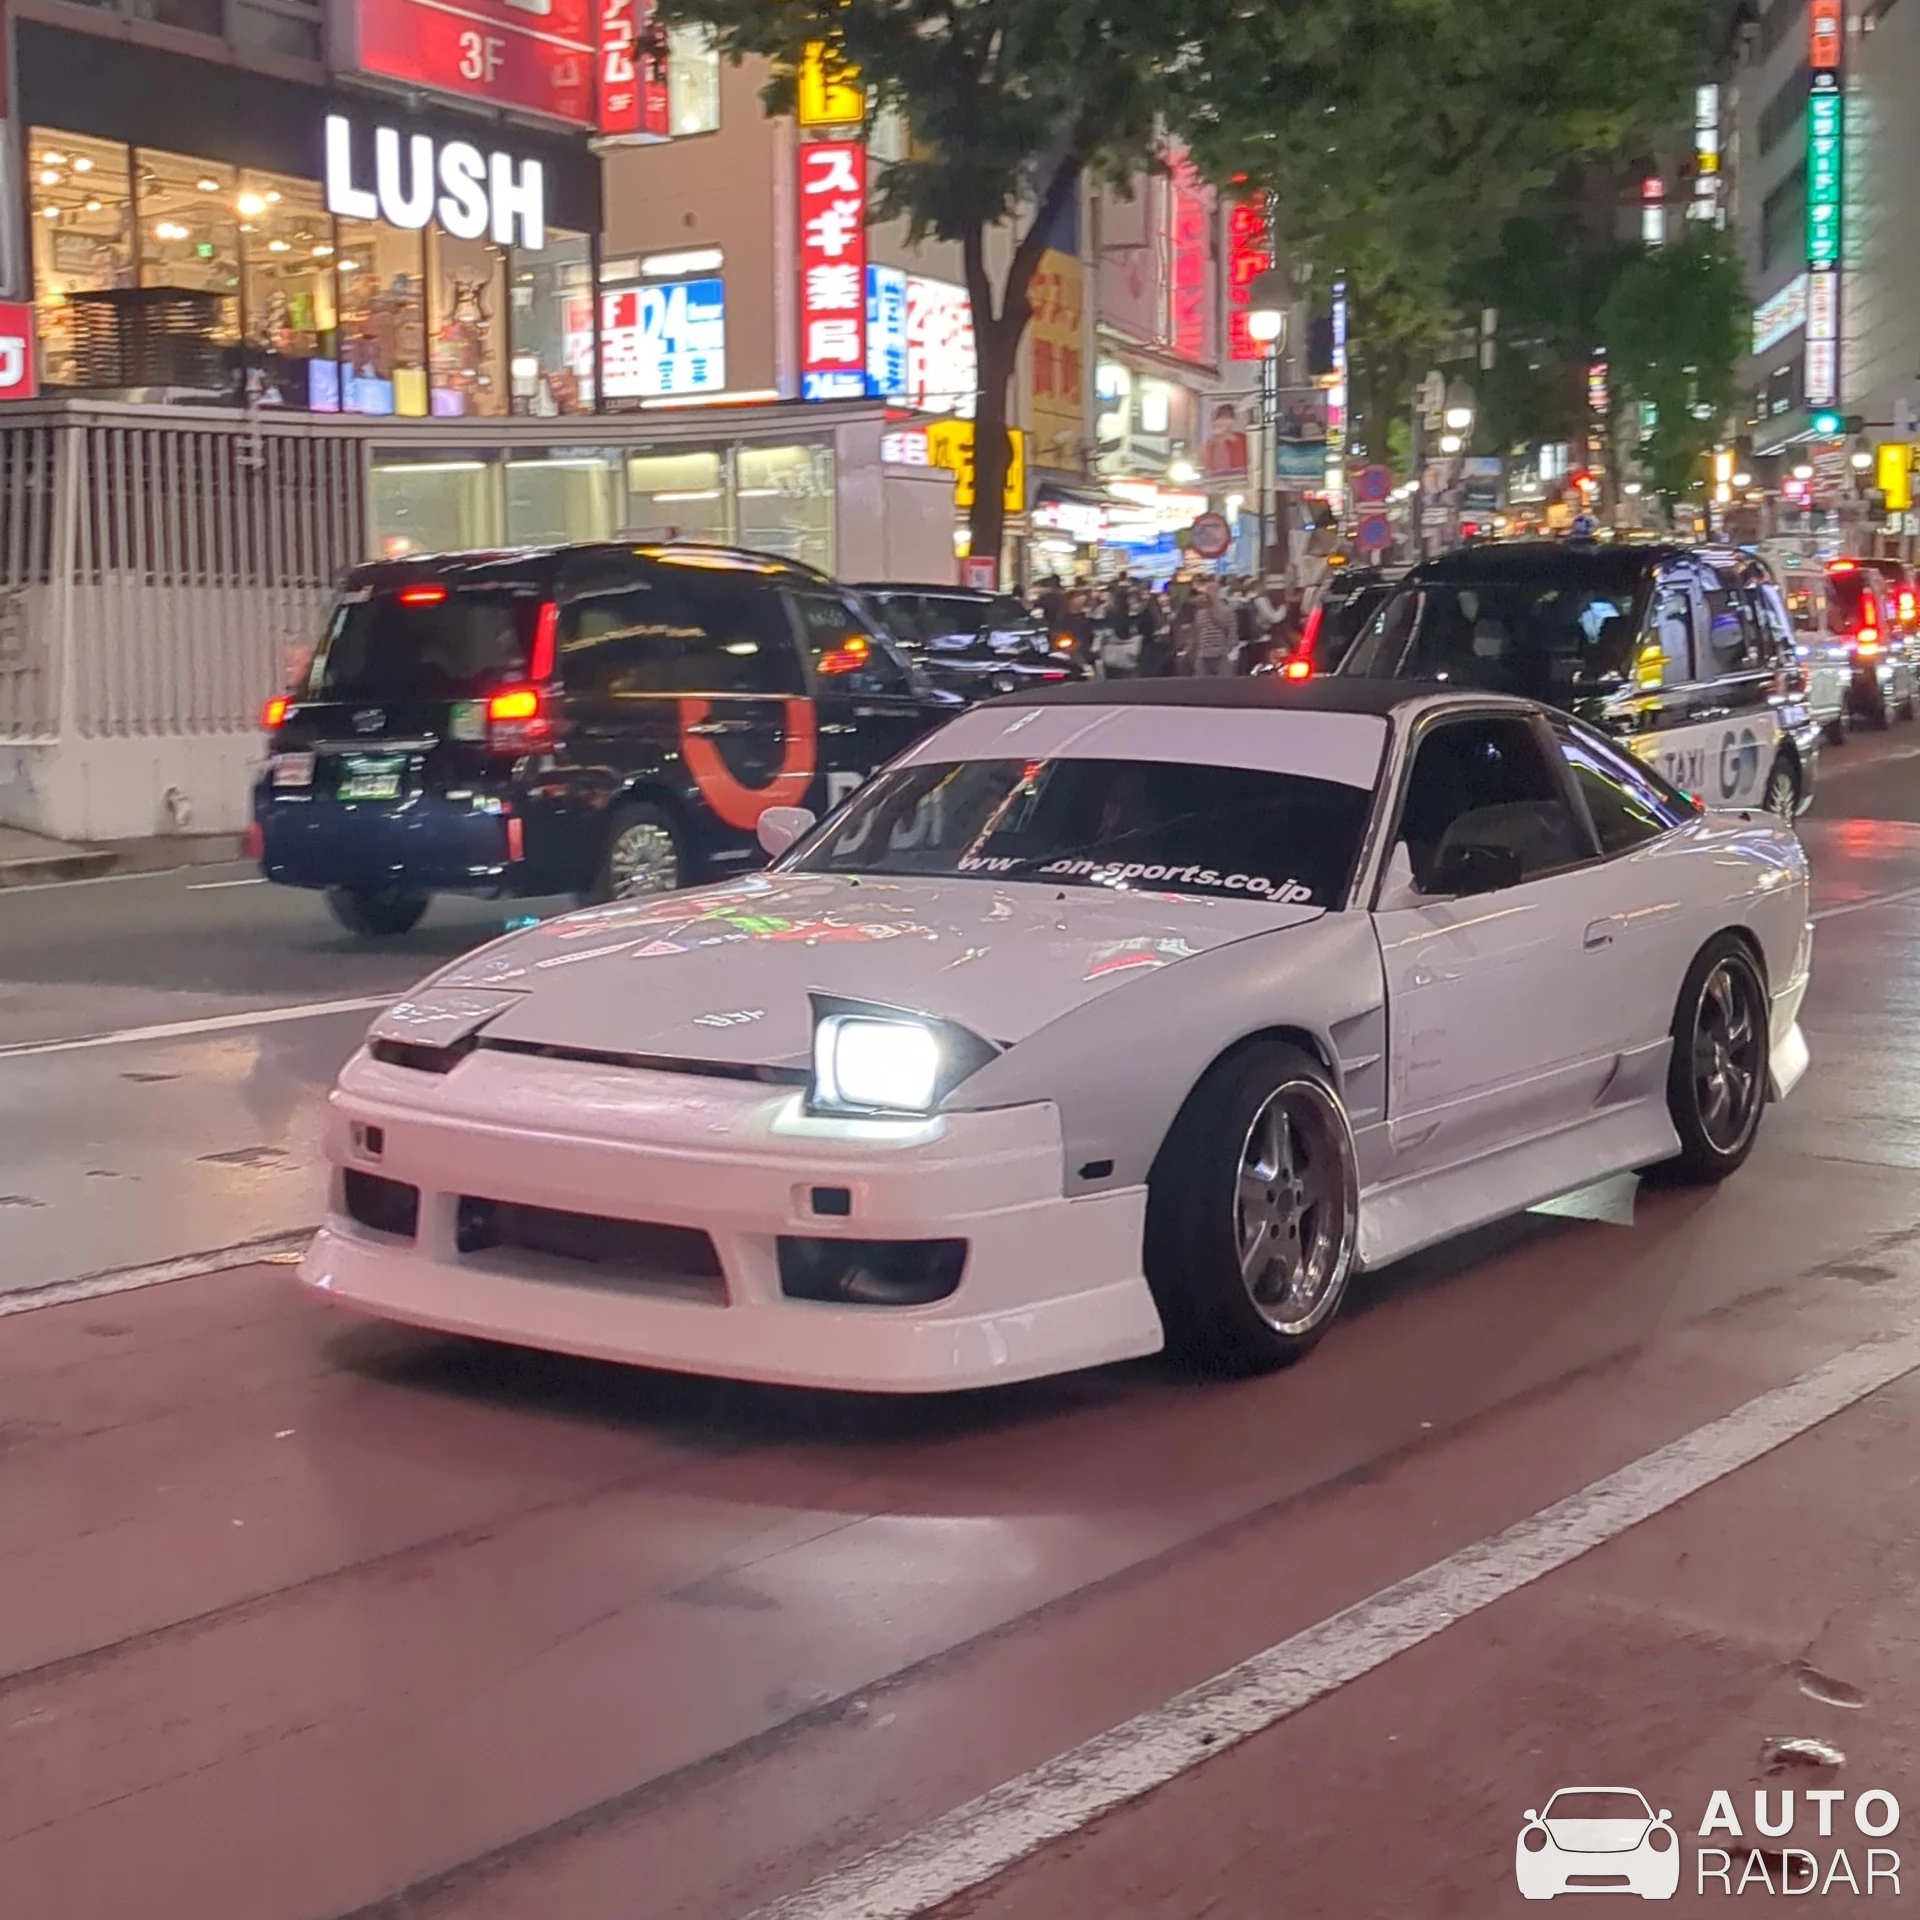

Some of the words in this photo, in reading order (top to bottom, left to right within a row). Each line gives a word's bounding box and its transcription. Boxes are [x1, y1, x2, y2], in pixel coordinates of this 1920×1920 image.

[458, 31, 506, 83] 3F
[326, 114, 544, 250] LUSH
[804, 150, 861, 364] スギ薬局
[1720, 728, 1758, 799] GO
